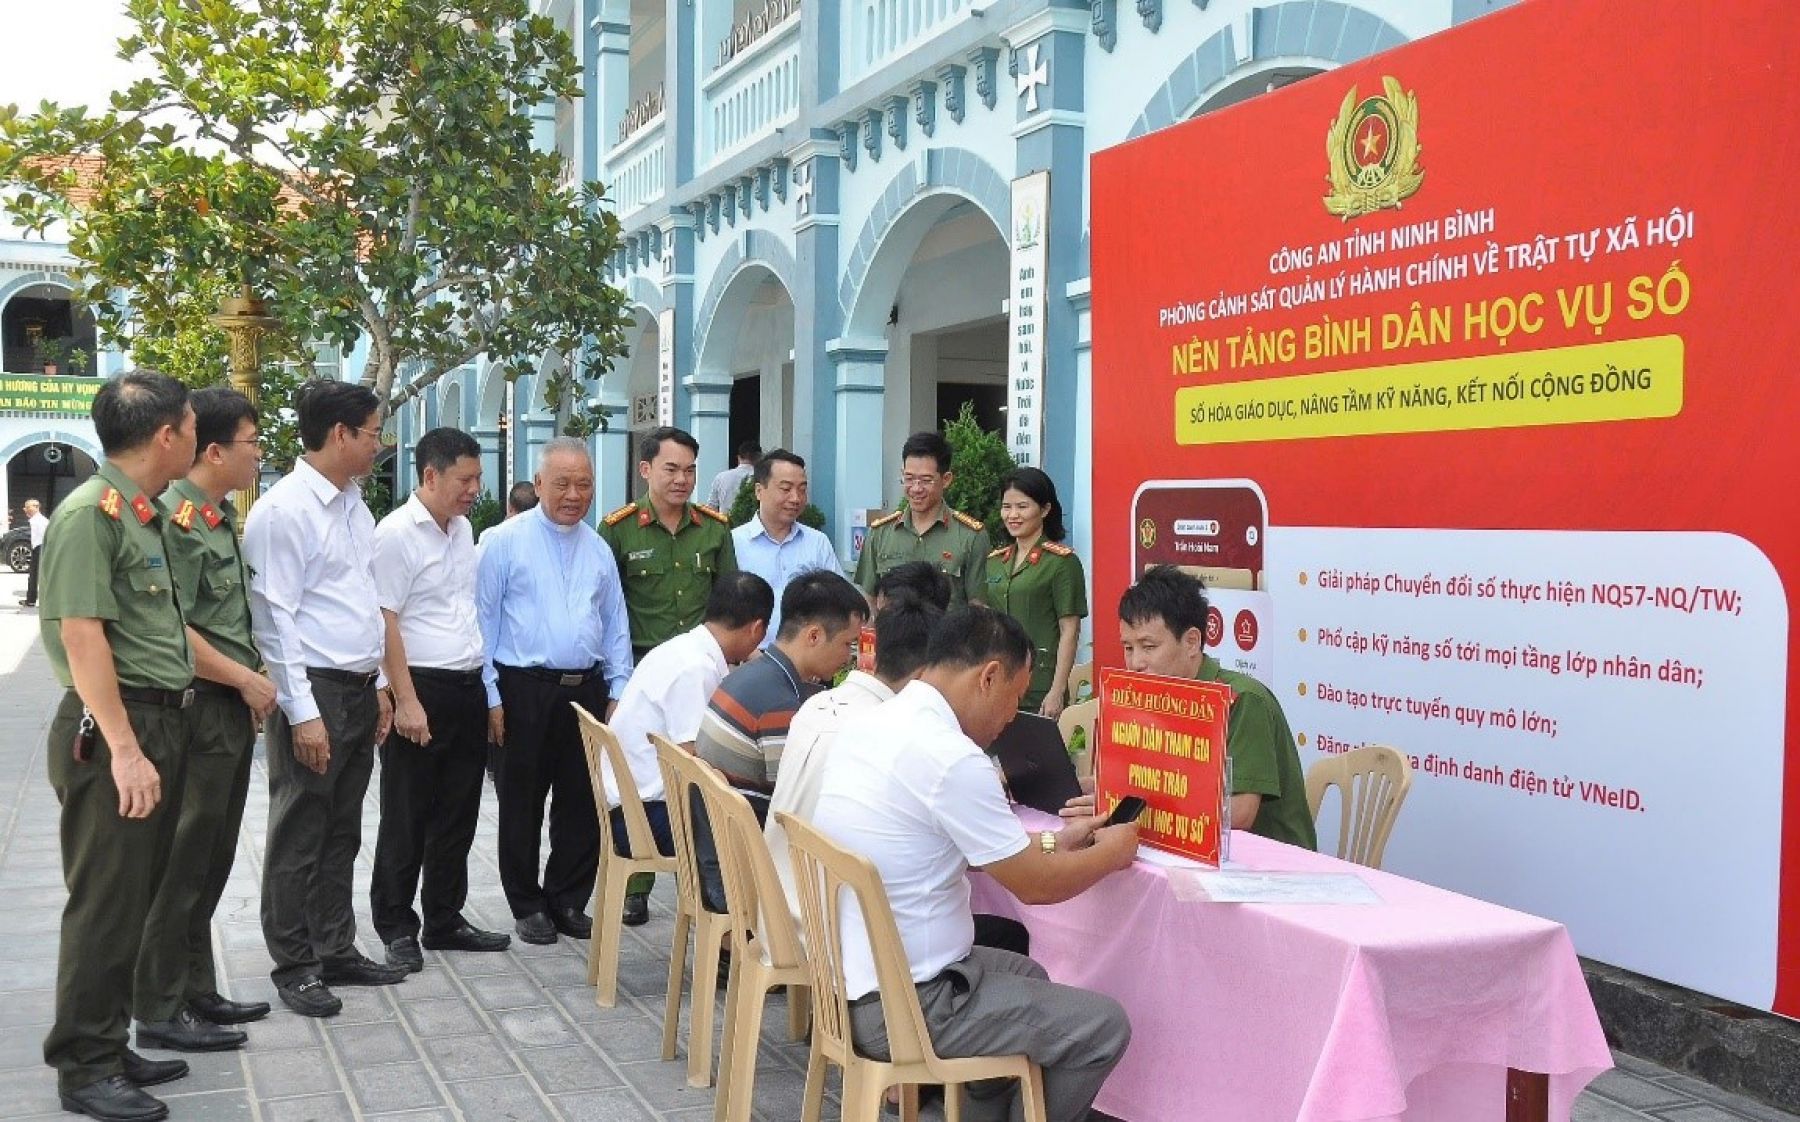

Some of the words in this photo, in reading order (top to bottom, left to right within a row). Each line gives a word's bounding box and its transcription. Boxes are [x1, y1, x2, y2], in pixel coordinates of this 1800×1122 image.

[1159, 301, 1205, 328] PHÒNG
[1208, 290, 1247, 319] CẢNH
[1250, 285, 1277, 313] SÁT
[1279, 274, 1326, 309] QUẢN
[1330, 270, 1346, 299] LÝ
[1350, 266, 1400, 296] HÀNH
[1405, 253, 1468, 286] CHÍNH
[1473, 240, 1499, 275] VỀ
[1504, 234, 1560, 271] TRẬT
[1565, 227, 1600, 263] TỰ
[1605, 216, 1640, 253] XÃ
[1647, 206, 1694, 247] HỘI
[1269, 246, 1313, 274] CÔNG
[1317, 241, 1341, 265] AN
[1344, 228, 1385, 259] TỈNH
[1391, 219, 1439, 250] NINH
[1444, 207, 1495, 240] BÌNH
[1226, 326, 1296, 368] TẢNG
[1305, 315, 1371, 360] BÌNH
[1381, 301, 1451, 350] DÂN
[1464, 292, 1544, 346] HỌC
[1556, 281, 1612, 335] VỤ
[1627, 259, 1690, 320] SỐ
[62, 382, 74, 393] HY
[1190, 401, 1205, 424] SỐ
[1208, 402, 1233, 422] HÓA
[1235, 399, 1264, 421] GIÁO
[1268, 399, 1297, 421] DỤC,
[1300, 393, 1338, 415] NÂNG
[1342, 387, 1372, 412] TẦM
[1376, 387, 1396, 409] KỸ
[1400, 384, 1451, 409] NĂNG,
[1457, 376, 1487, 405] KẾT
[1492, 372, 1524, 401] NỐI
[1530, 372, 1584, 402] CỘNG
[1590, 363, 1651, 394] ĐỒNG
[1318, 568, 1343, 589] Giải
[1346, 572, 1380, 595] pháp
[1385, 573, 1441, 597] Chuyển
[1446, 573, 1472, 597] đổi
[1477, 575, 1496, 598] số
[1500, 578, 1541, 604] thực
[1546, 580, 1585, 607] hiện
[1592, 583, 1742, 616] NQ57-NQ/TW;
[1345, 630, 1368, 654] cập
[1372, 632, 1389, 656] kỹ
[1393, 635, 1430, 661] năng
[1434, 637, 1454, 659] số
[1456, 641, 1480, 662] tới
[1485, 646, 1517, 670] mọi
[1522, 643, 1561, 675] tầng
[1566, 650, 1597, 678] lớp
[1603, 654, 1651, 679] nhân
[1658, 659, 1703, 689] dân;
[1112, 683, 1142, 707] ĐIỂM
[1145, 692, 1188, 715] HƯỚNG
[1190, 695, 1215, 720] DẪN
[1317, 683, 1343, 702] Đào
[1346, 688, 1367, 709] tạo
[1372, 691, 1402, 715] trực
[1406, 696, 1450, 721] tuyến
[1455, 707, 1485, 729] quy
[1489, 709, 1516, 729] mô
[1522, 710, 1558, 738] lớn;
[1112, 719, 1141, 748] NGƯỜI
[1142, 723, 1163, 753] DÂN
[1165, 730, 1193, 758] THAM
[1194, 737, 1210, 763] GIA
[1128, 763, 1161, 792] PHONG
[1163, 768, 1188, 798] TRÀO
[1424, 753, 1458, 778] định
[1463, 762, 1503, 786] danh
[1510, 768, 1547, 795] điện
[1552, 774, 1574, 798] tử
[1579, 781, 1645, 812] VNeID.
[1153, 809, 1174, 839] HỌC
[1176, 813, 1189, 844] VỤ
